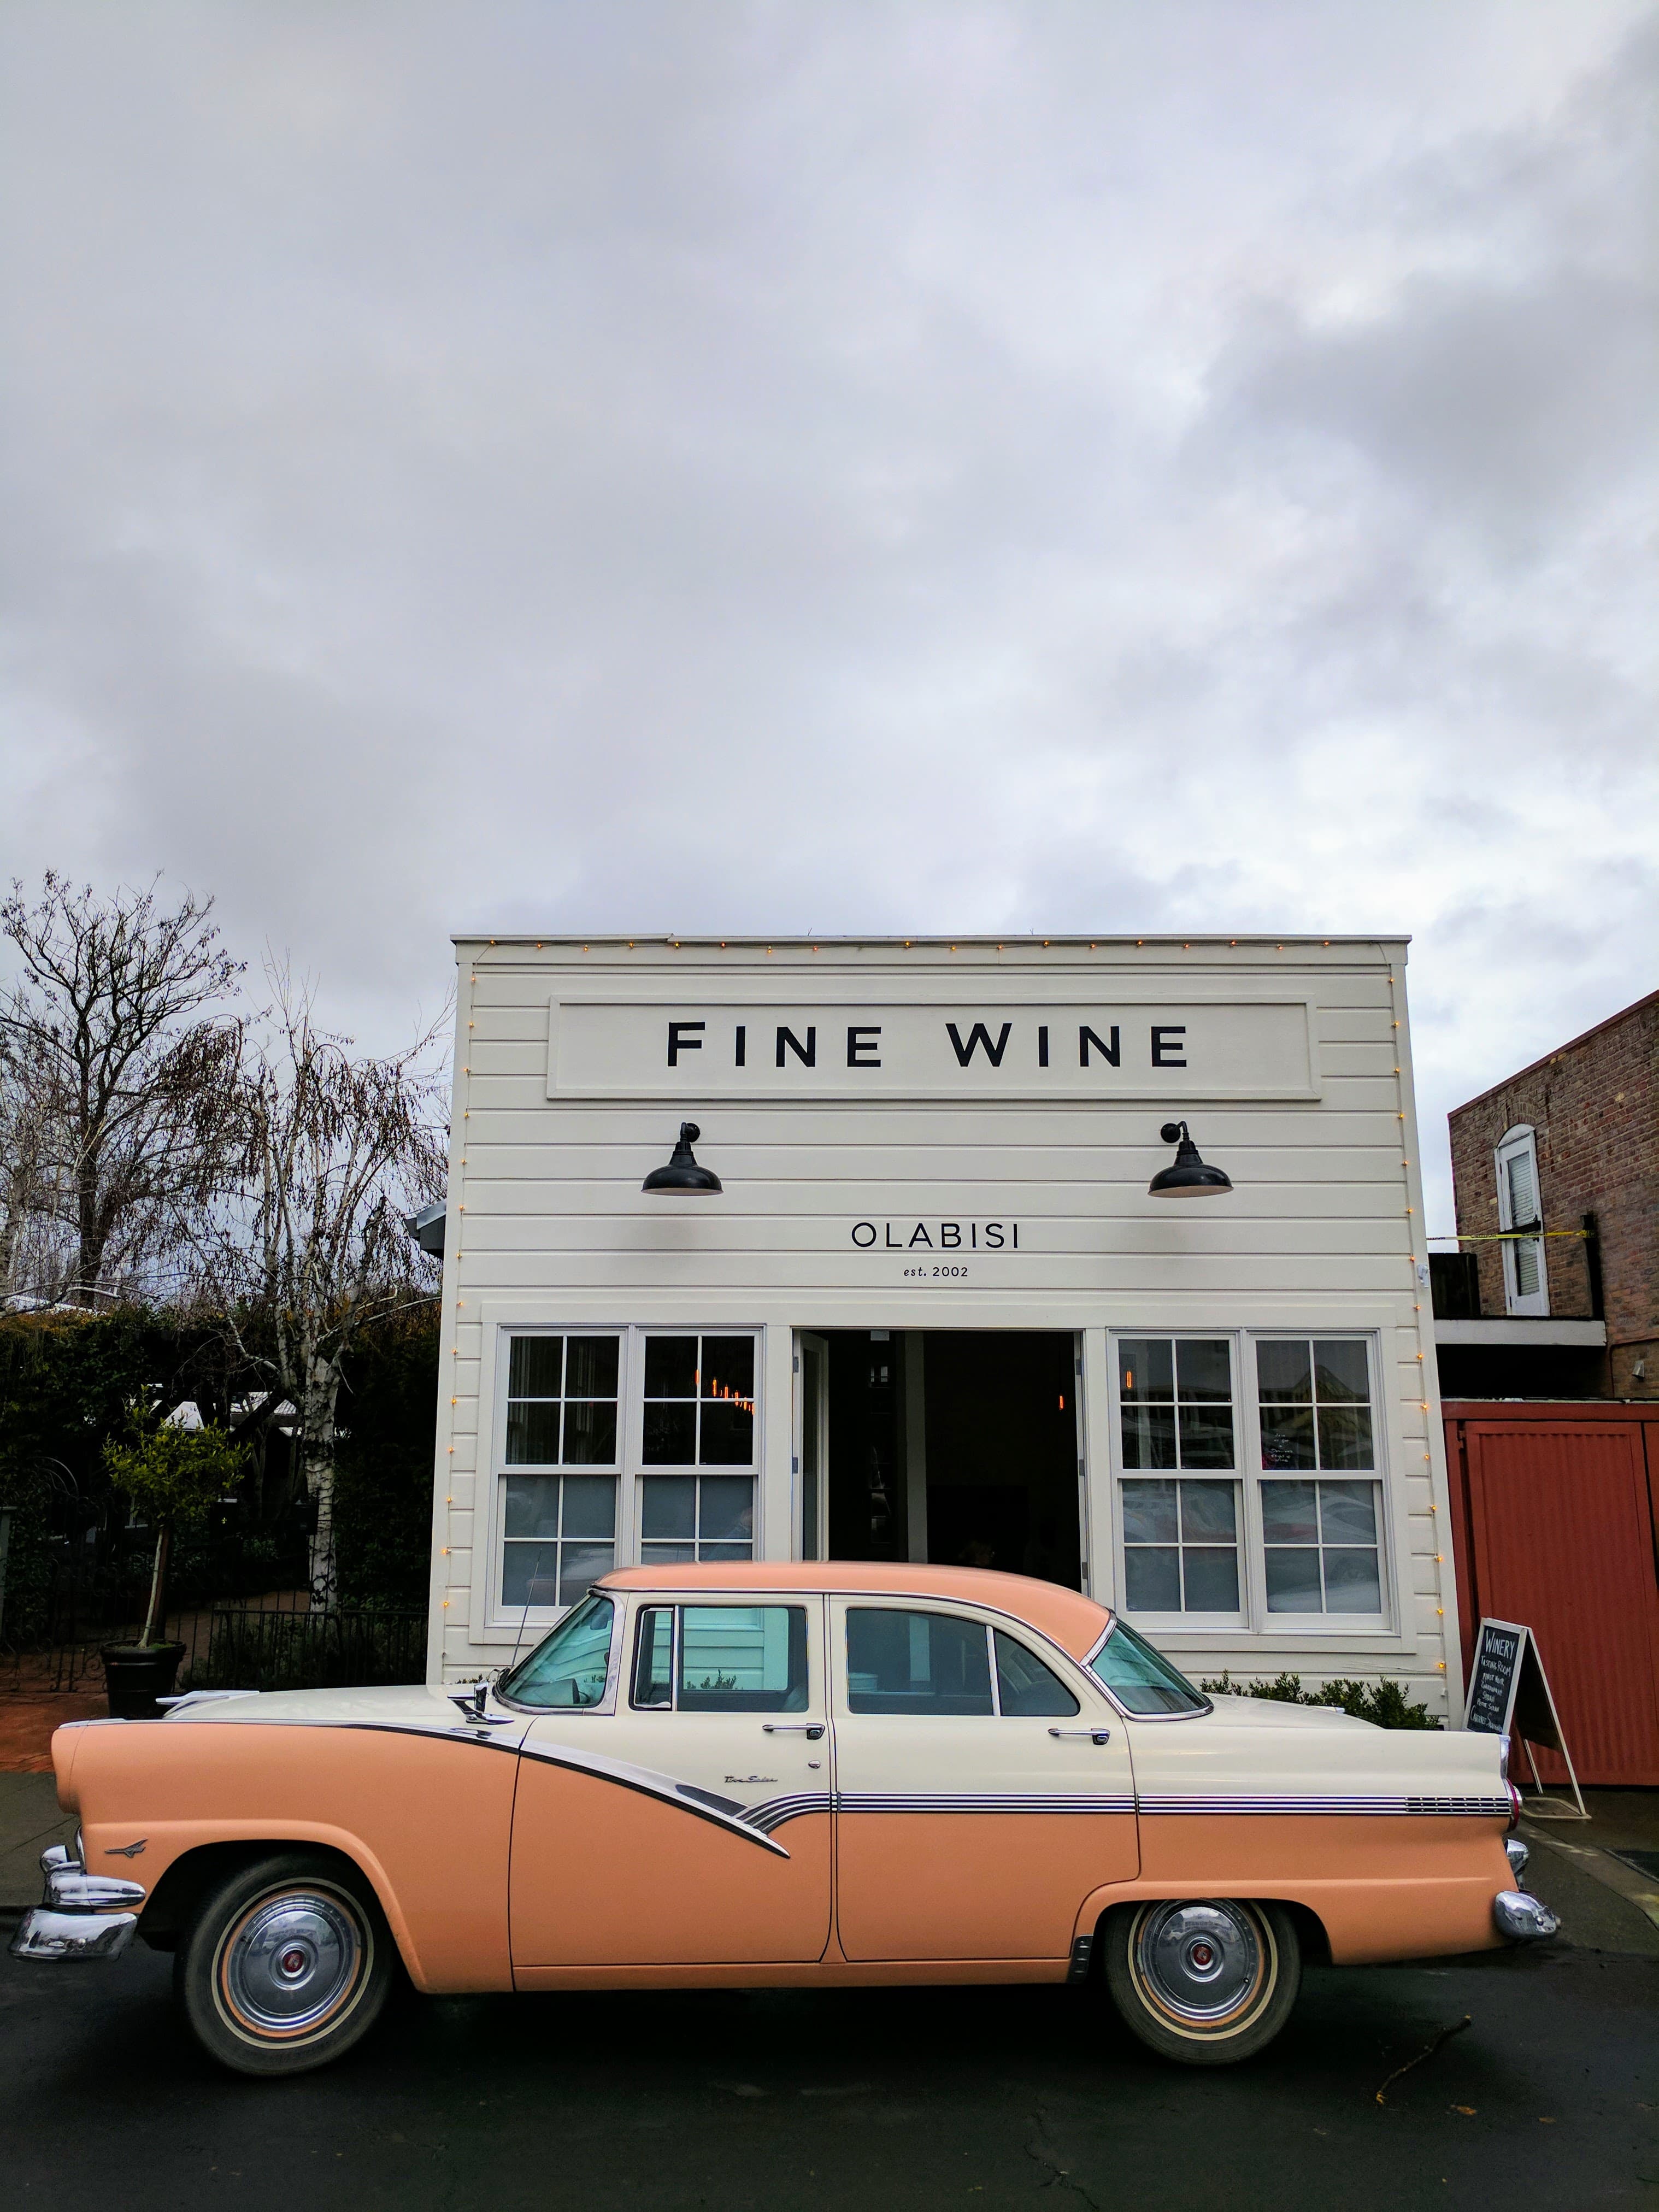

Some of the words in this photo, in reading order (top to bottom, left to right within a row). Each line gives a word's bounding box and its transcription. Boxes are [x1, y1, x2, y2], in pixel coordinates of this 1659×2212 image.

[667, 1021, 882, 1068] FINE
[945, 1022, 1187, 1068] WINE
[851, 1222, 1019, 1249] OLABISI
[903, 1267, 927, 1277] est.
[932, 1267, 968, 1277] 2002
[1485, 1629, 1515, 1660] WINERY
[1497, 1660, 1511, 1677] ROOM
